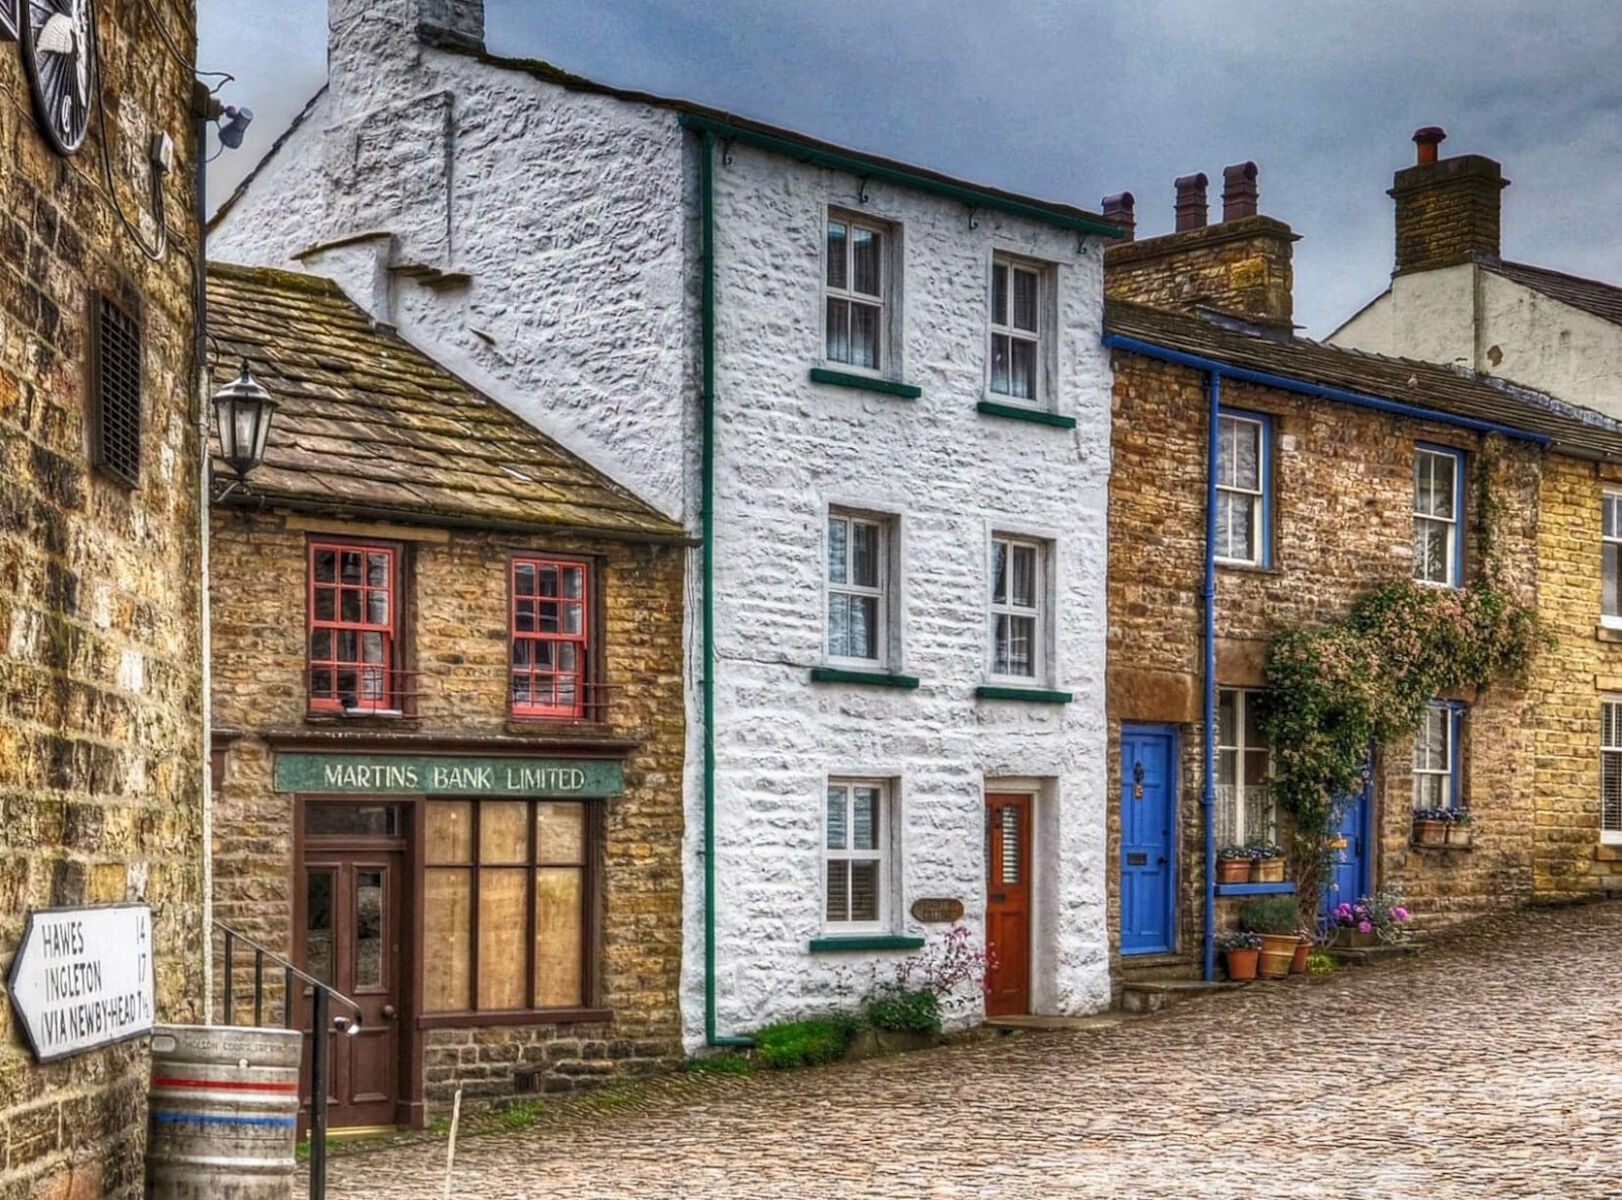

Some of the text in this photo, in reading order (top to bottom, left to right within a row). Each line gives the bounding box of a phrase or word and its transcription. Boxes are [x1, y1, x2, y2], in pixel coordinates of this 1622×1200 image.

[324, 764, 584, 791] MARTINS BANK LIMITED
[42, 915, 146, 958] HAWES 14
[45, 953, 147, 1003] INGLETON 17
